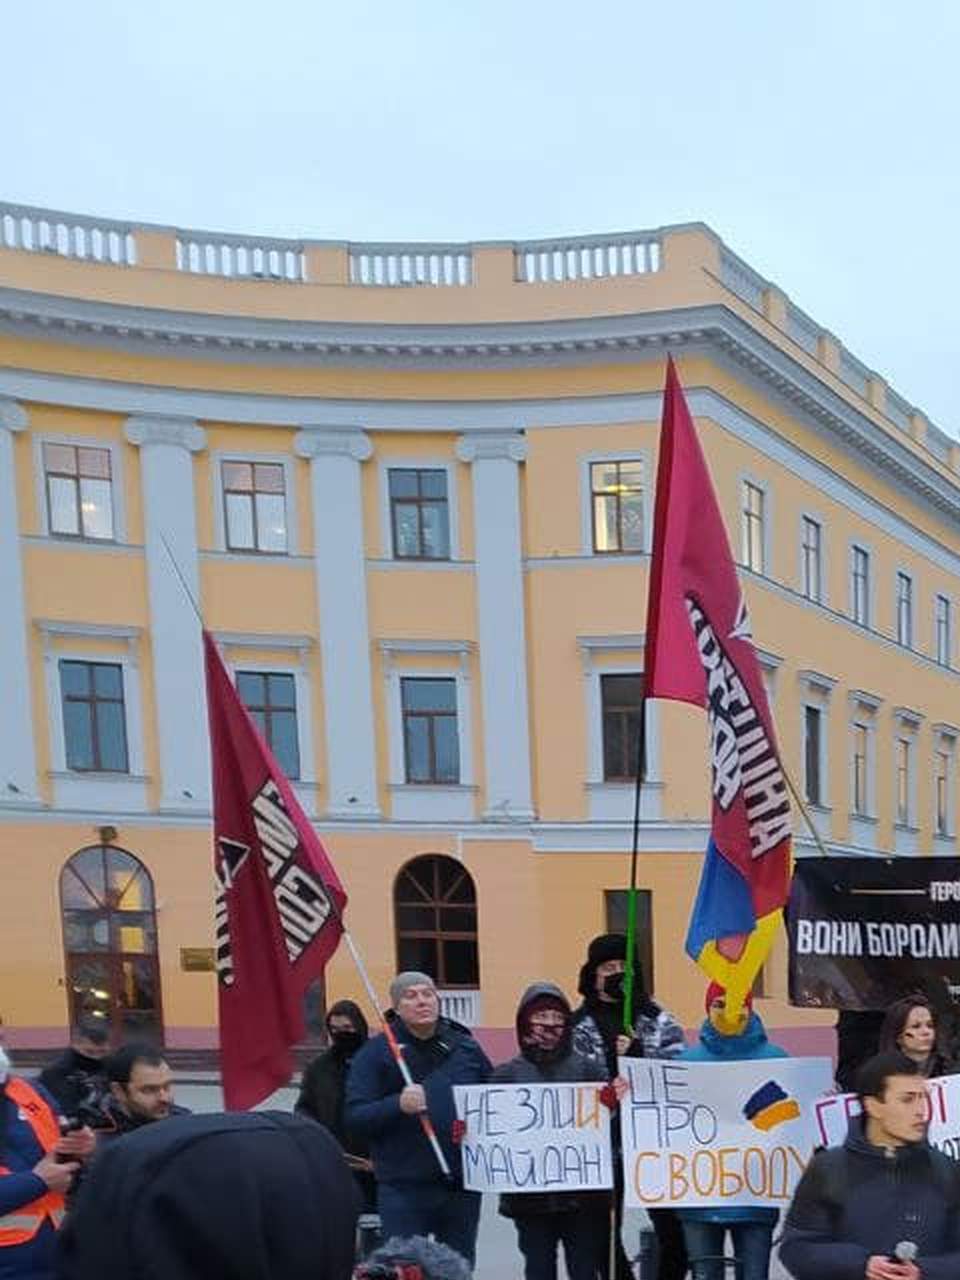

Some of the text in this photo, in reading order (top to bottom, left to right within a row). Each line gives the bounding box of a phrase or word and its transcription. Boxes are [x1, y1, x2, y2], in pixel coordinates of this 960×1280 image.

[797, 920, 862, 956] ВОНИ
[628, 1065, 692, 1105] ЦЕ
[464, 1088, 507, 1137] НЕ
[631, 1104, 719, 1149] ПРО
[464, 1143, 602, 1188] МАЙДАН
